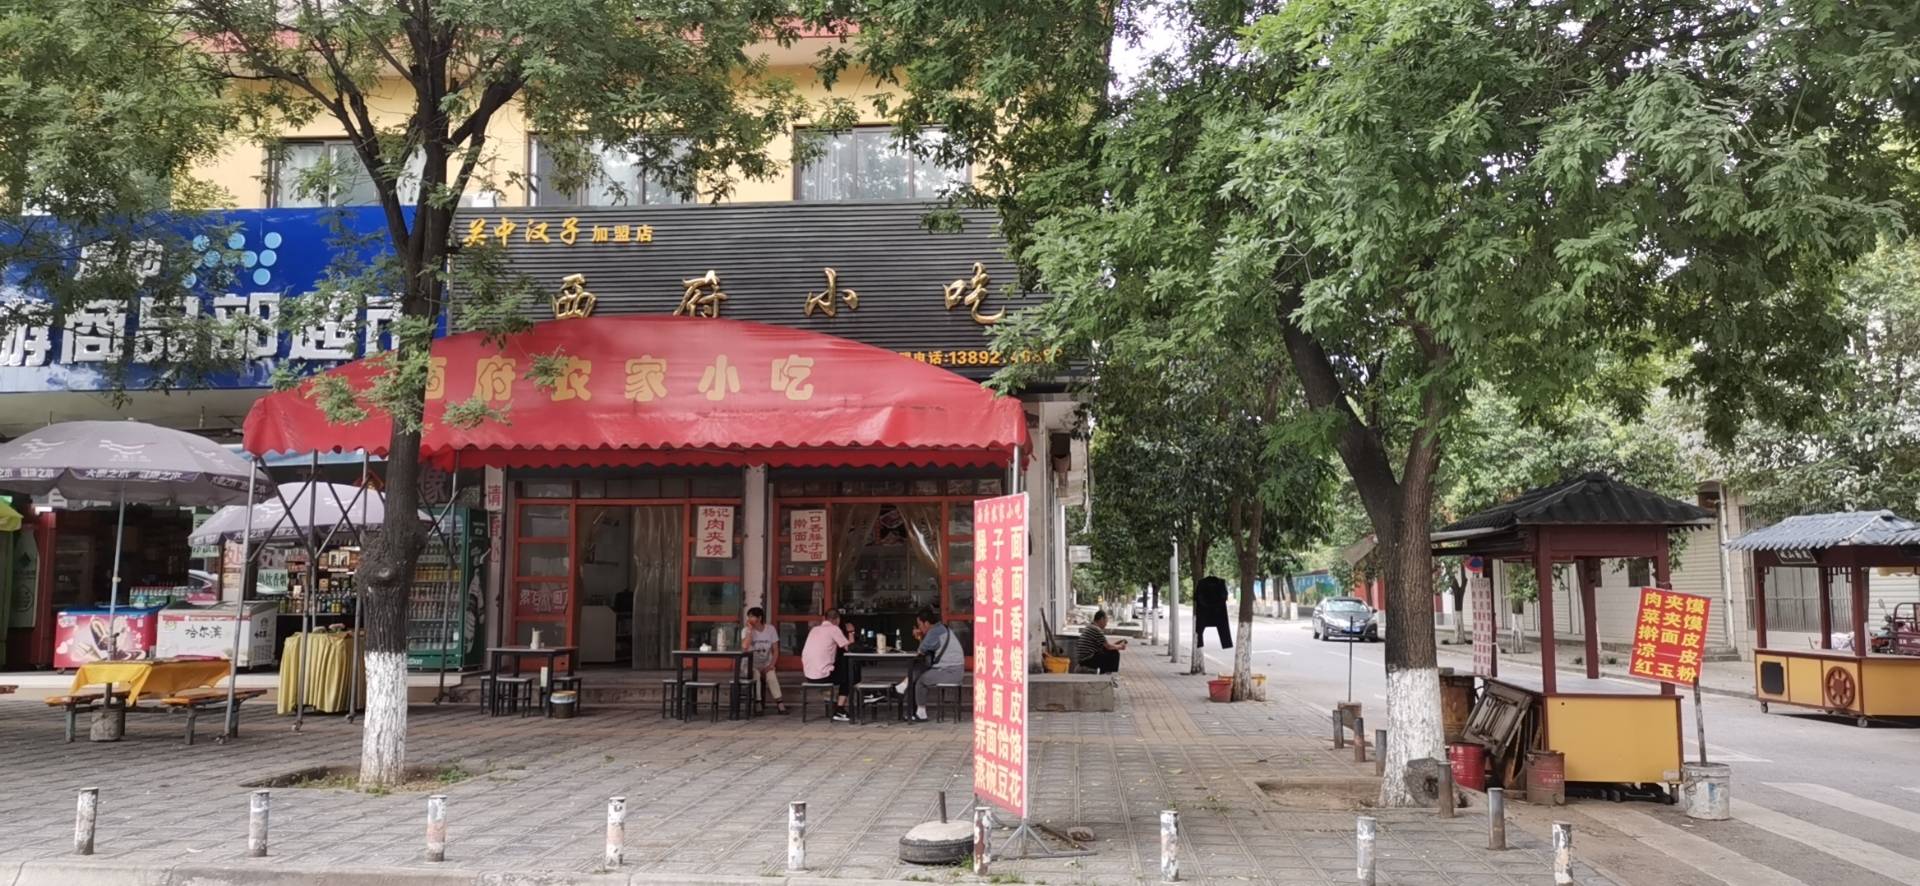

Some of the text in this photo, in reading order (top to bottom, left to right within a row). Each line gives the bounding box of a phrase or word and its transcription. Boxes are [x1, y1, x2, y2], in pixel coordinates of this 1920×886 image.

[463, 217, 654, 247] 关中汉子 加盟店
[553, 262, 1005, 324] 西府小吃
[703, 519, 726, 556] 肉夹馍
[1641, 607, 1703, 632] 菜夹馍
[1645, 591, 1706, 615] 肉夹馍
[976, 605, 1023, 641] 一口香
[1637, 624, 1700, 649] 擀面皮
[976, 641, 1023, 684] 肉夹馍
[974, 754, 1022, 808] 蒸碗豆花
